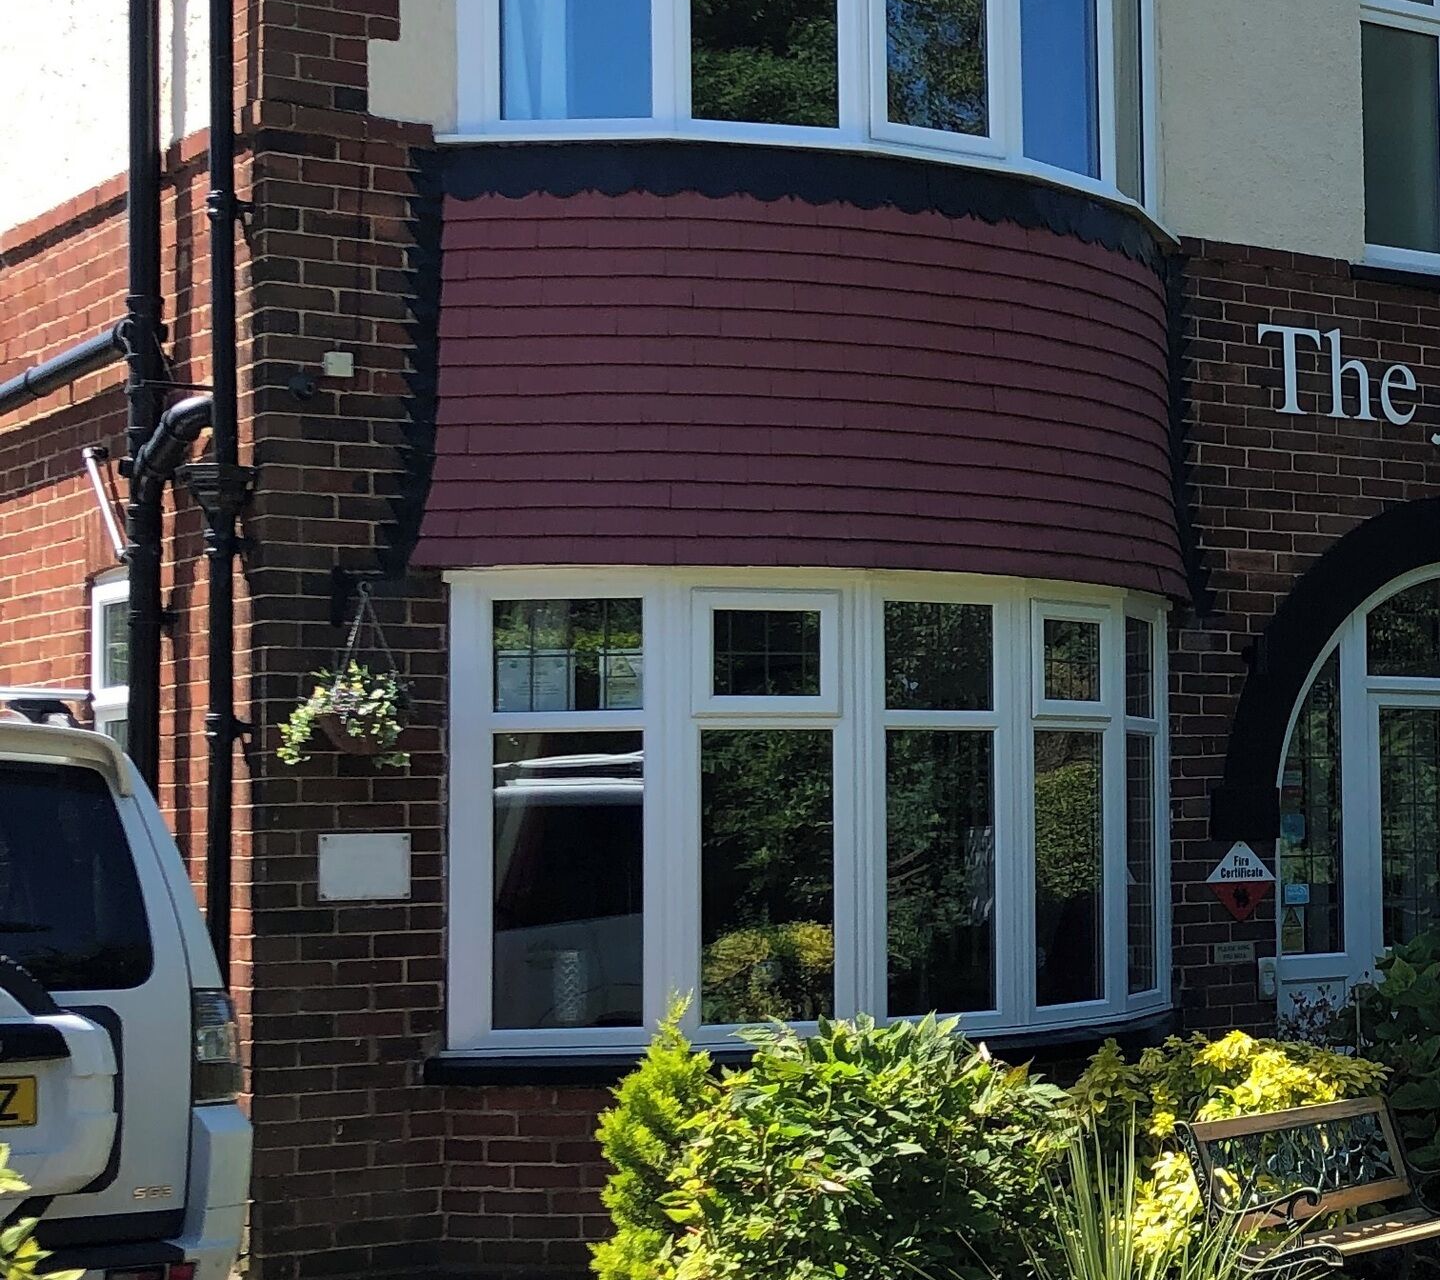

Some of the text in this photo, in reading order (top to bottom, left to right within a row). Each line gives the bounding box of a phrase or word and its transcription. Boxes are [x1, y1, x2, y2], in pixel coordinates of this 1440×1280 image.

[1257, 322, 1417, 426] The
[1233, 855, 1250, 867] Fire
[1220, 867, 1264, 879] Certificate
